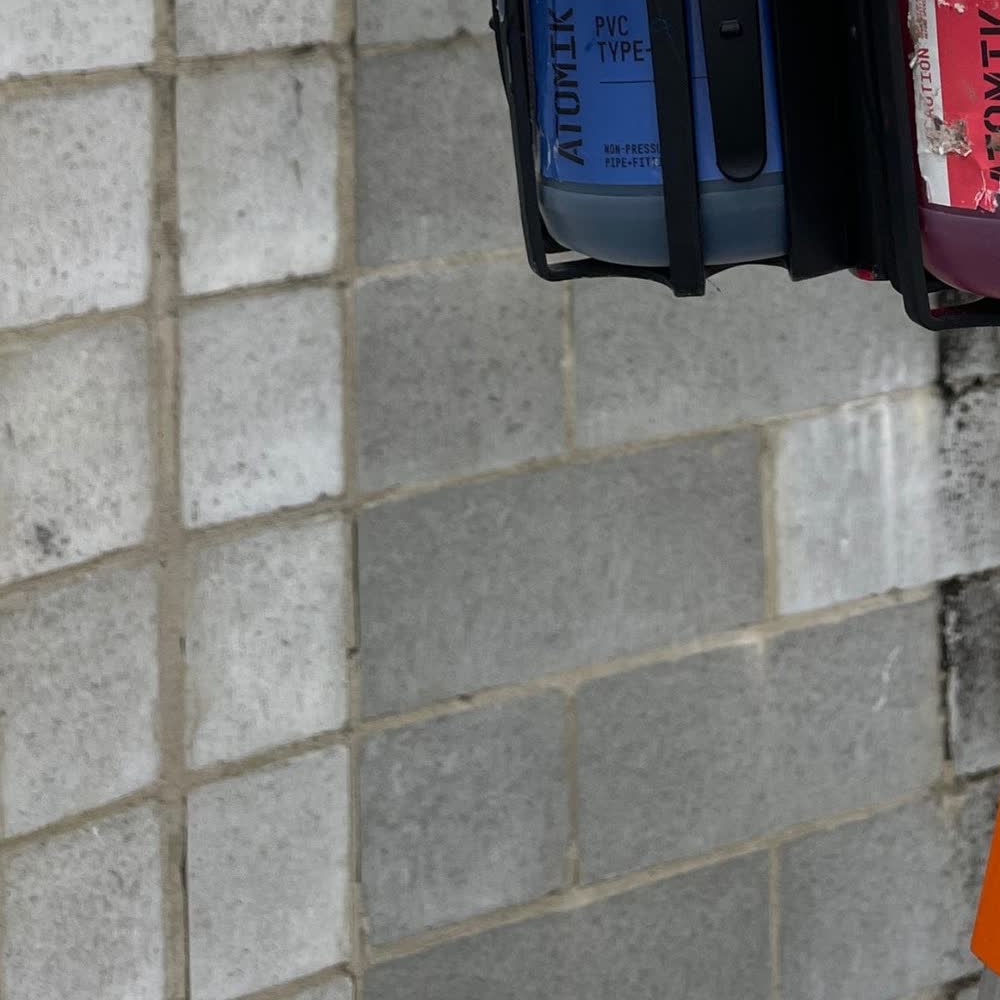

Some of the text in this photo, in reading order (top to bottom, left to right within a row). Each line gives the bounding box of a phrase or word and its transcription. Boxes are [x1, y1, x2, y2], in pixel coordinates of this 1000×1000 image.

[595, 15, 629, 36] PVC
[597, 40, 652, 63] TYPE-
[547, 8, 584, 166] ATOMIK
